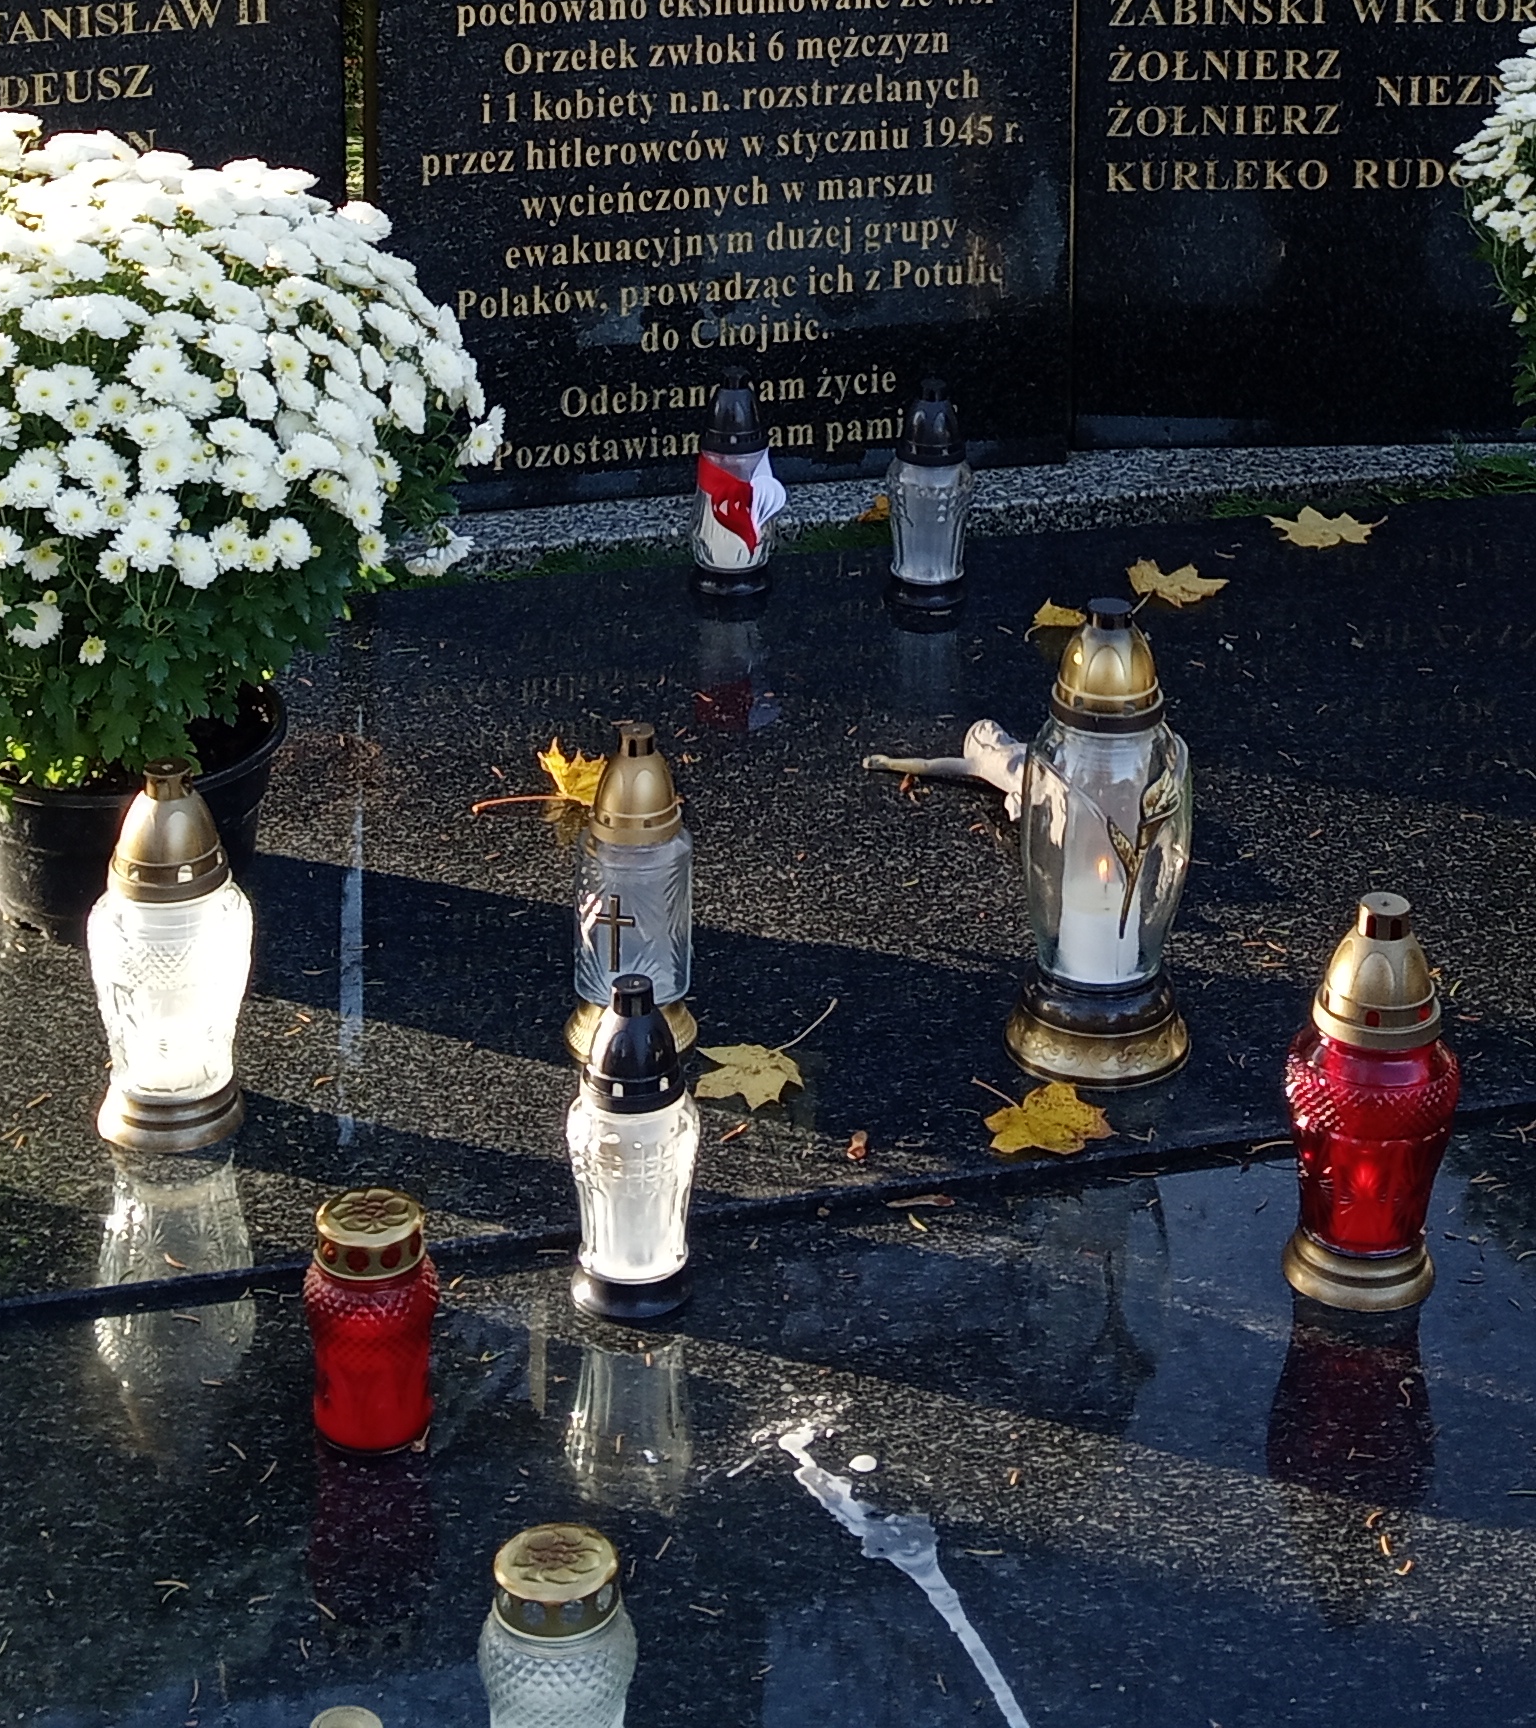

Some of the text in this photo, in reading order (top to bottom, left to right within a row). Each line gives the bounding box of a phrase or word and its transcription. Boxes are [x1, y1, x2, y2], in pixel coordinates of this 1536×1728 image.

[504, 29, 948, 71] Orzełek zwłoki 6 mężczyzn
[1108, 46, 1341, 81] ŻOŁNIERZ
[482, 69, 980, 123] i 1 kobiety n.n. rozstrzelanych
[1108, 102, 1339, 136] ŻOŁNIERZ
[423, 117, 1023, 185] przez hitlerowców w styczniu 1945 r.
[1107, 160, 1327, 190] KURLEKO
[522, 173, 934, 227] wycieńczonych w marszu
[506, 217, 957, 269] ewakuacyjnym dużej grupy
[458, 253, 1003, 321] Polaków, prowadząc ich z Potulic
[641, 316, 829, 356] do Chojnic.
[562, 367, 895, 419] Odebran am życie
[492, 425, 700, 470] Pozostawian
